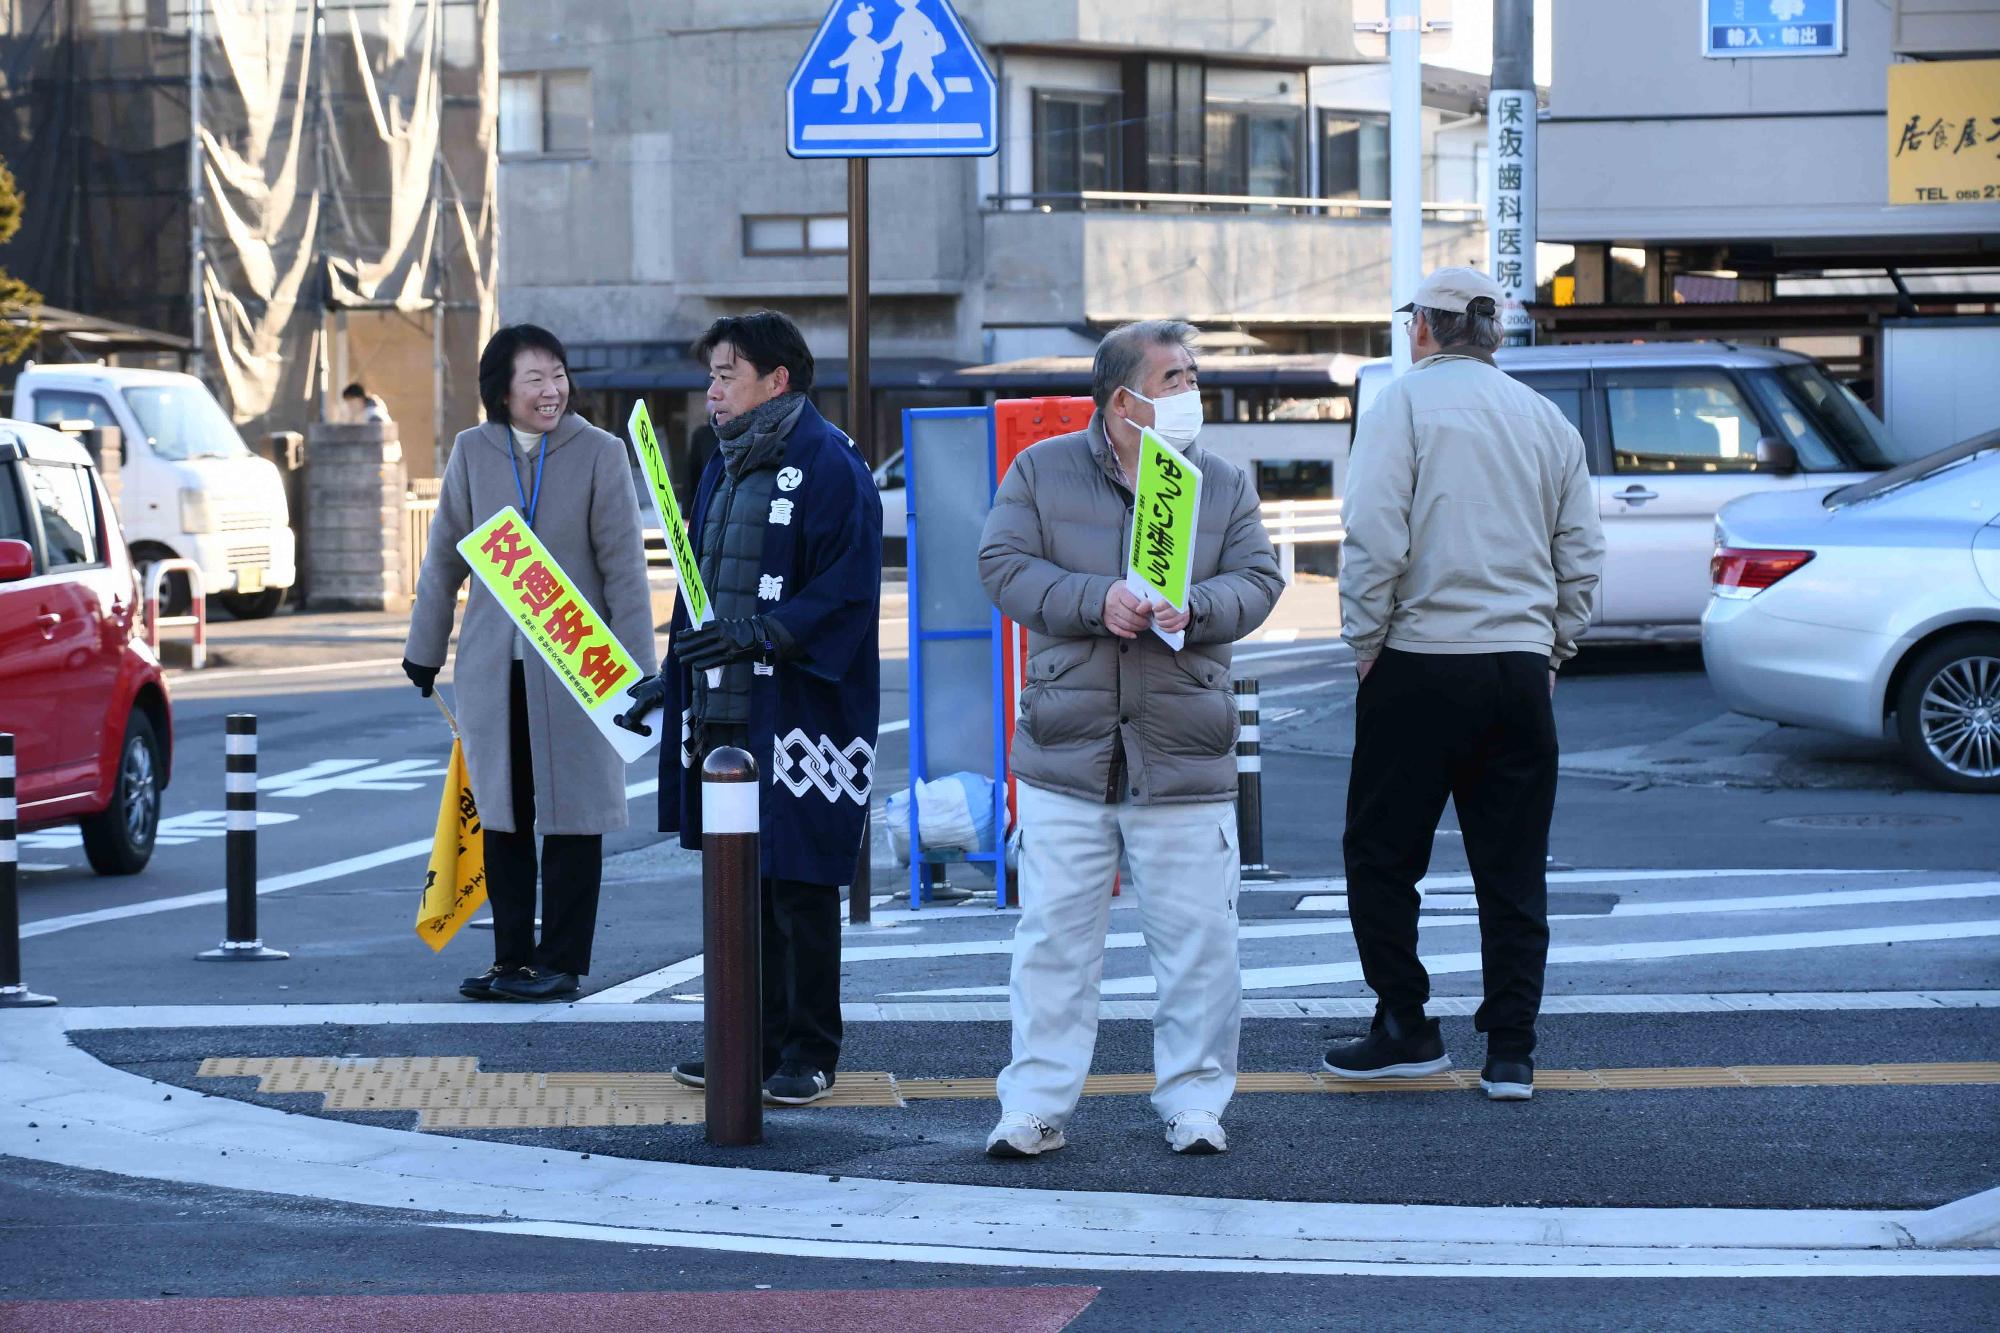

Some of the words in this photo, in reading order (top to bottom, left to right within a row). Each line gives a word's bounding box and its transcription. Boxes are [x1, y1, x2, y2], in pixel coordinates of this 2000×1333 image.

[1727, 26, 1818, 47] 輸入・輸出
[1497, 96, 1523, 289] 保坂歯科医院
[1915, 187, 1949, 201] TEL
[640, 418, 704, 609] ゆっくり走ろう
[1147, 452, 1183, 588] ゆっくり走ろう
[480, 519, 629, 698] 交通安全
